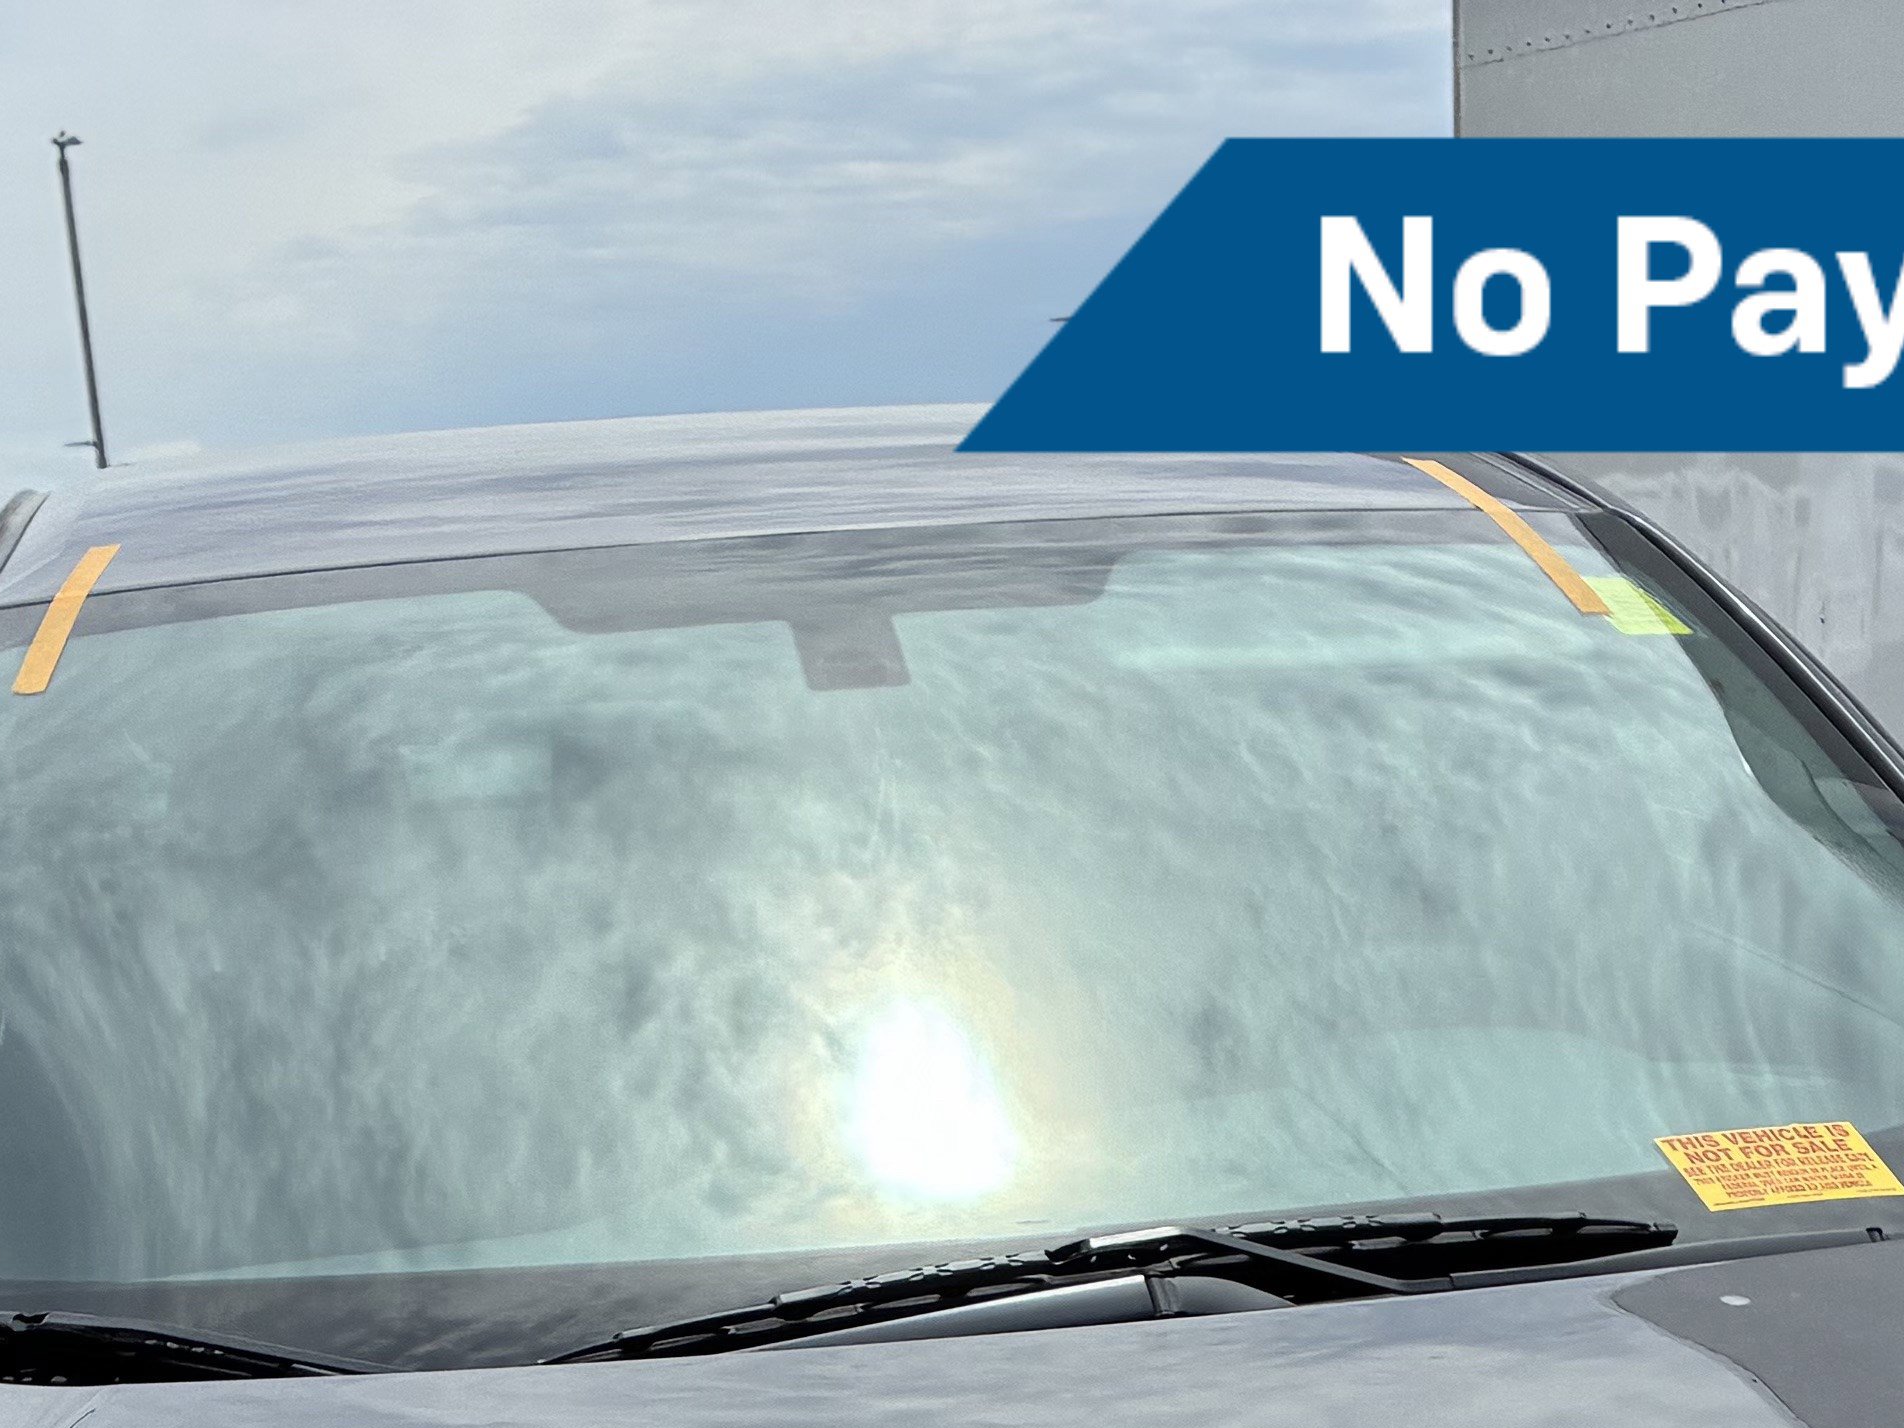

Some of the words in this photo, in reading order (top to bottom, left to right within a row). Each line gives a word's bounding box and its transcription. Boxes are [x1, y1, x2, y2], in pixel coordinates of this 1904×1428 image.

[1661, 1135, 1720, 1151] THIS
[1721, 1126, 1822, 1146] VEHICLE
[1825, 1124, 1850, 1137] IS
[1683, 1147, 1733, 1164] NOT
[1739, 1143, 1790, 1159] FOR
[1791, 1138, 1853, 1155] SALE
